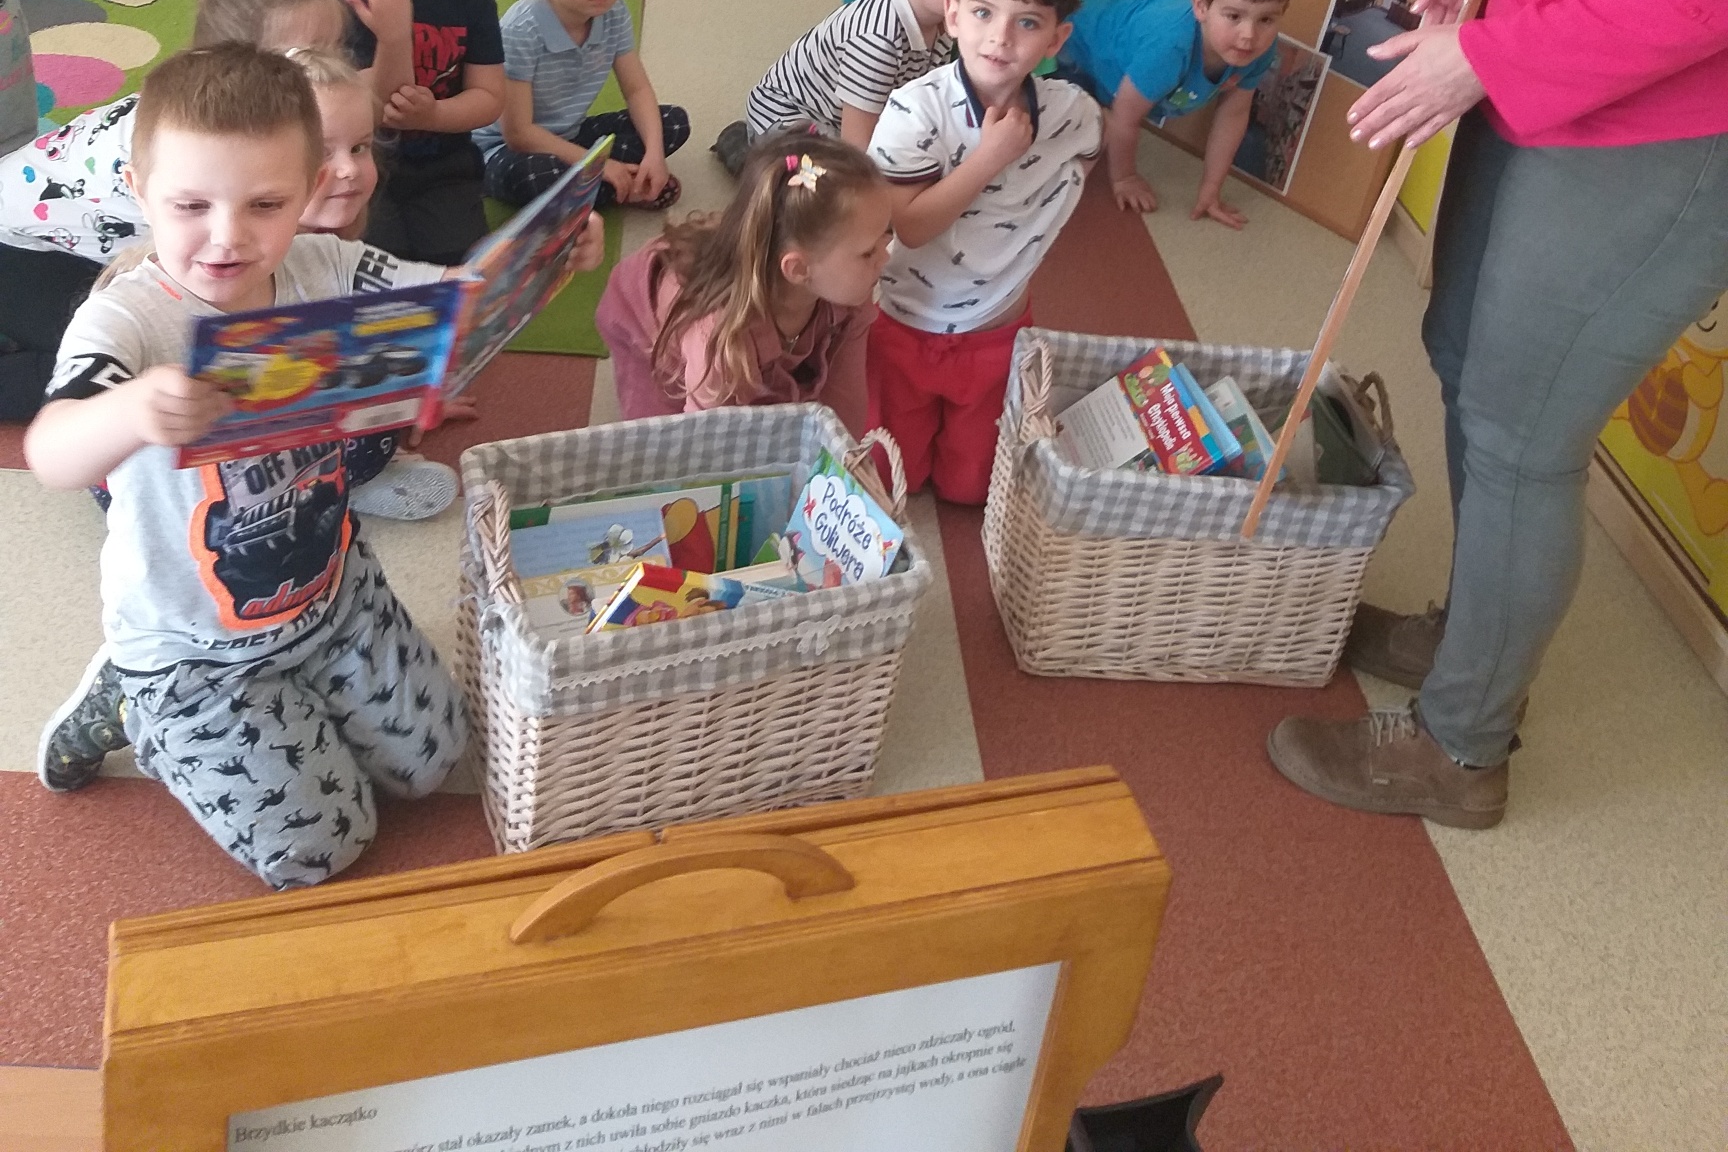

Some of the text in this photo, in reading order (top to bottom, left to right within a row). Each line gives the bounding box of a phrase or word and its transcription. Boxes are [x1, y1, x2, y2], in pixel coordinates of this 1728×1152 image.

[1147, 402, 1177, 451] encyklopedia
[1160, 381, 1192, 440] Moja pierwsza
[814, 512, 864, 581] Guliwera
[822, 481, 872, 550] Podróże
[438, 1134, 463, 1151] stał
[466, 1124, 522, 1147] okazały
[525, 1115, 576, 1136] zamek,
[579, 1115, 588, 1126] a
[591, 1103, 637, 1123] dokoła
[641, 1098, 679, 1115] niego
[682, 1082, 743, 1106] rozciągał
[746, 1078, 764, 1093] się
[768, 1063, 830, 1088] wspaniały
[834, 1050, 880, 1072] chociaż
[883, 1042, 916, 1059] nieco
[918, 1028, 975, 1051] zdziczały
[576, 1131, 606, 1149] nich
[609, 1123, 647, 1142] uwiła
[651, 1117, 686, 1134] sobie
[689, 1104, 741, 1130] gniazdo
[744, 1095, 791, 1115] kaczka,
[795, 1084, 827, 1102] która
[878, 1068, 893, 1080] na
[894, 1054, 938, 1079] jajkach
[941, 1044, 994, 1063] okropnie
[996, 1041, 1014, 1054] się
[692, 1132, 710, 1147] się
[714, 1125, 745, 1140] wraz
[759, 1112, 788, 1130] nimi
[806, 1098, 843, 1117] falach
[845, 1081, 916, 1110] przejrzystej
[919, 1072, 954, 1088] wody,
[967, 1065, 989, 1078] ona
[991, 1056, 1027, 1074] ciągle
[234, 1106, 378, 1144] Brzydkie kaczątko
